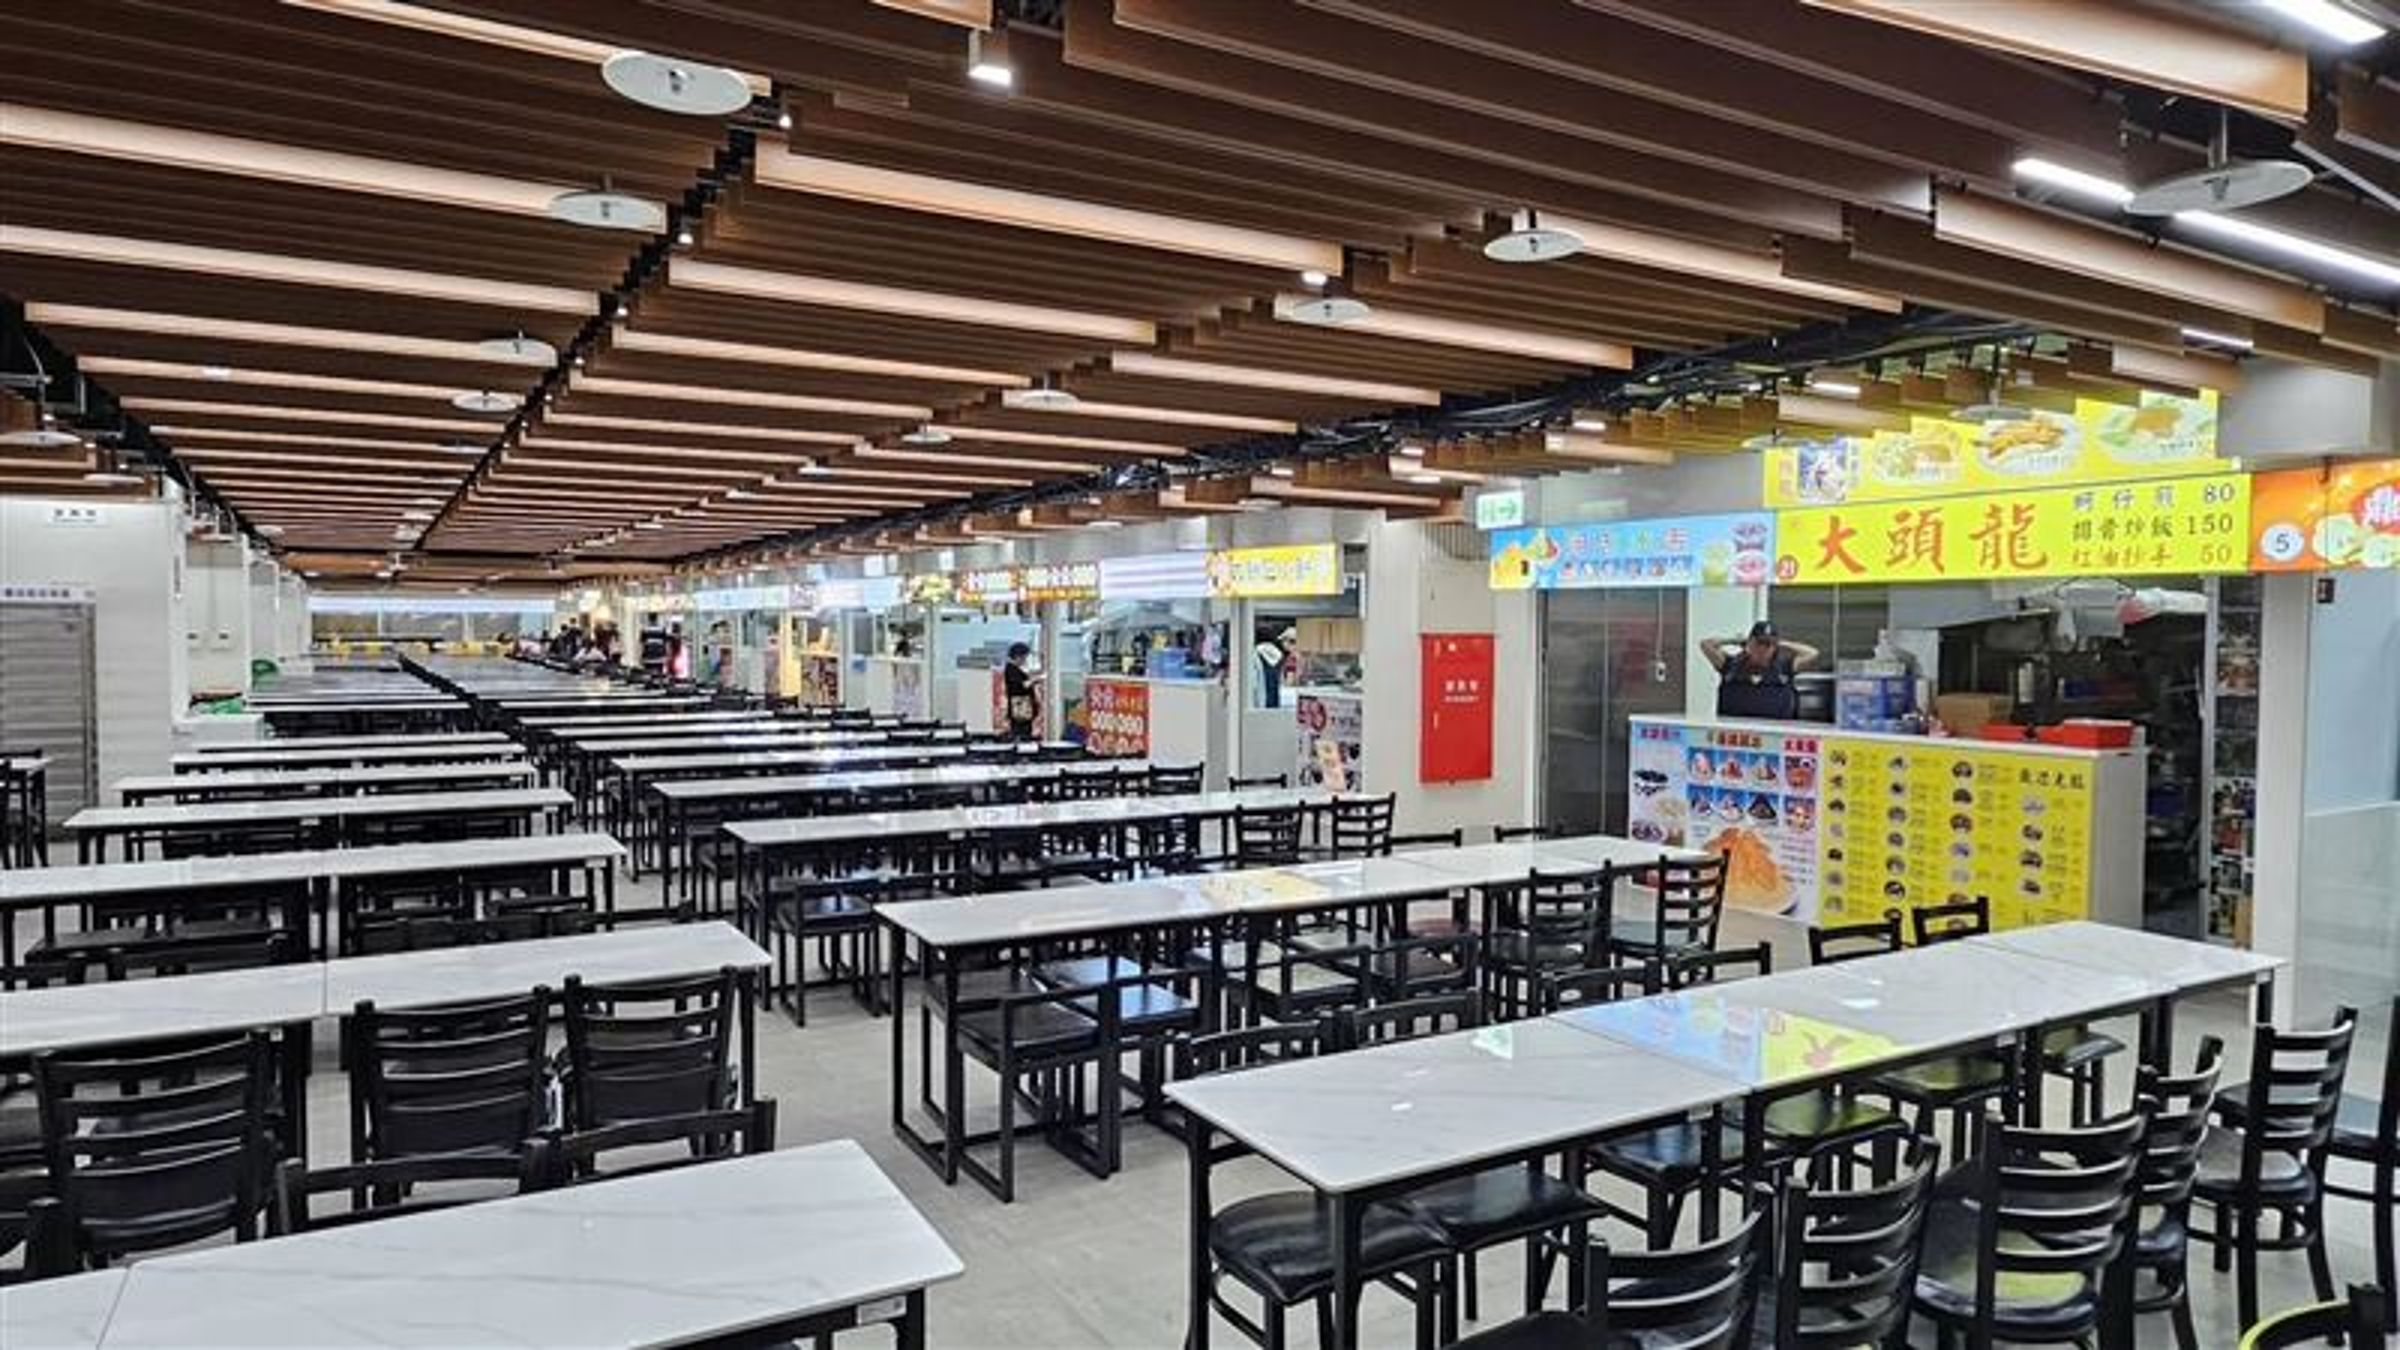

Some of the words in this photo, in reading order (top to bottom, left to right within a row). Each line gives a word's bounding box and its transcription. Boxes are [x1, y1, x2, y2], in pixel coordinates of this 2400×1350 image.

[2204, 482, 2236, 504] 80
[2187, 512, 2234, 535] 150
[1814, 501, 2049, 575] 大頭龍
[2274, 532, 2291, 553] 5
[2201, 543, 2233, 566] 50
